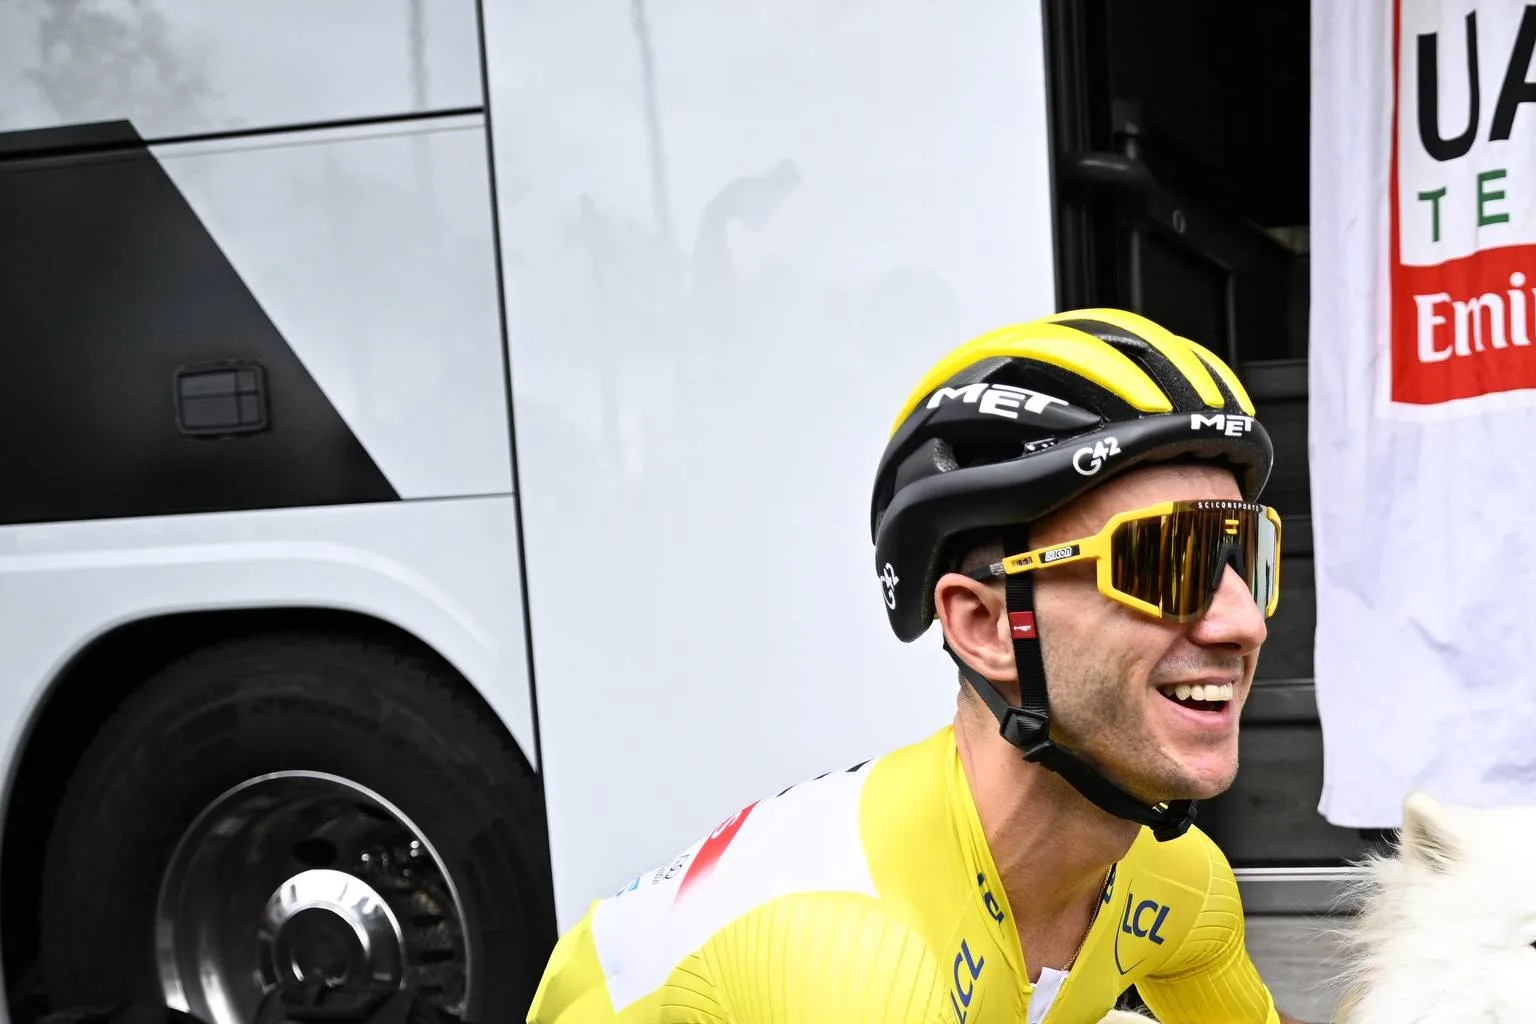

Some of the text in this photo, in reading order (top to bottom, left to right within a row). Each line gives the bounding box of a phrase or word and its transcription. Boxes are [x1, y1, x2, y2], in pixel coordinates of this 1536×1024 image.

[926, 382, 1069, 419] MET
[1190, 413, 1255, 437] MET
[1197, 501, 1260, 512] SCICONSPORTS
[1122, 892, 1171, 945] LCL
